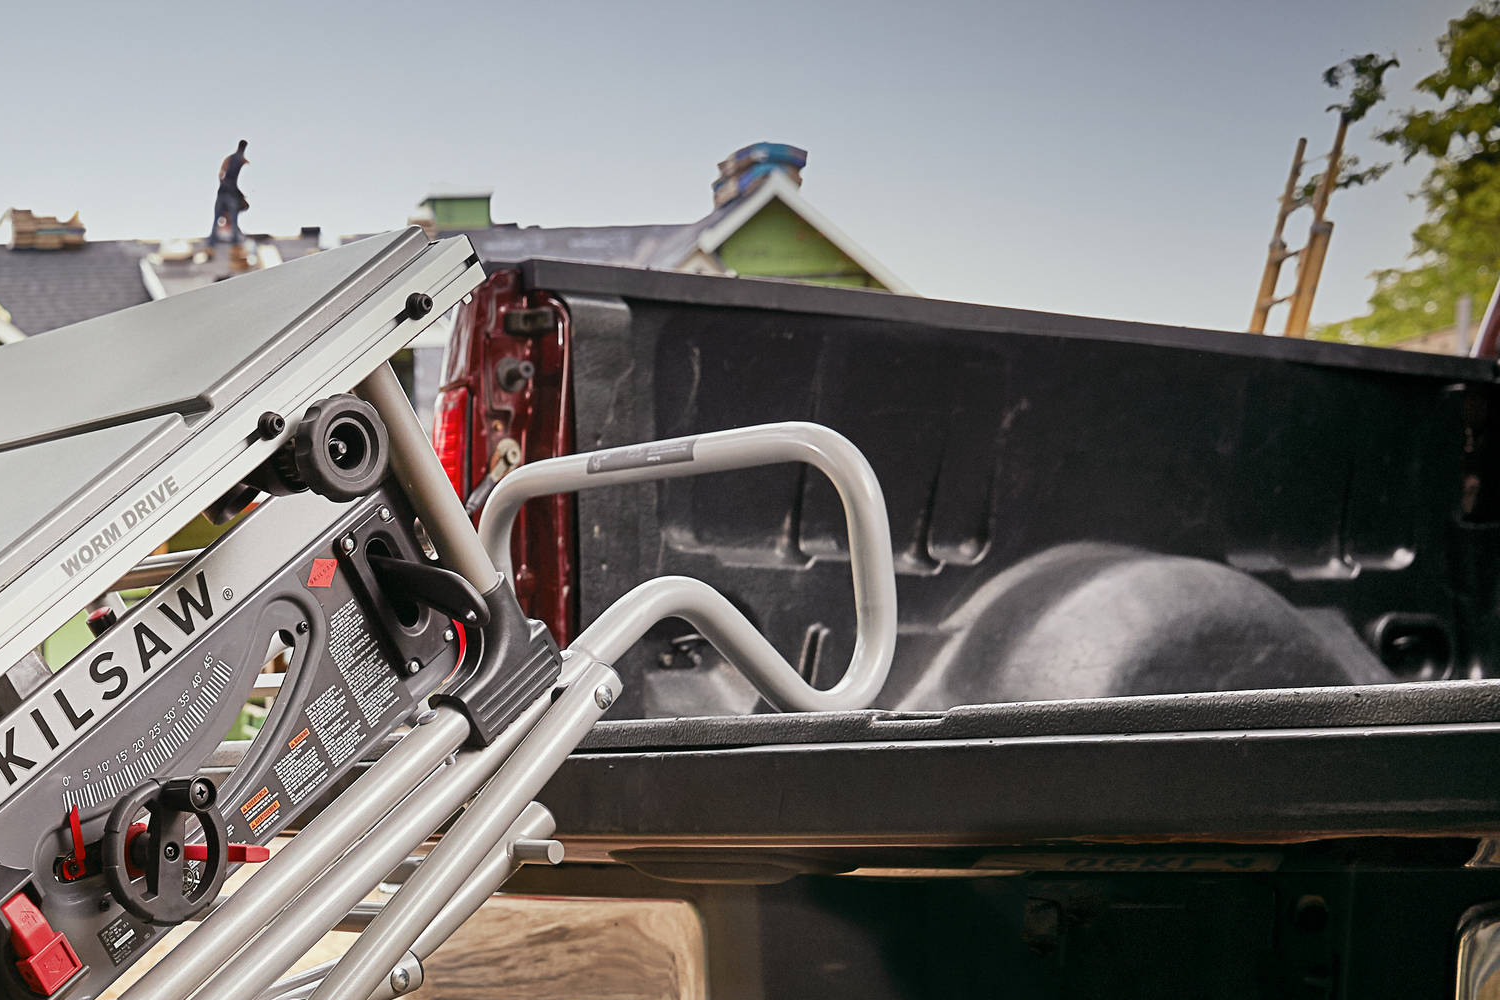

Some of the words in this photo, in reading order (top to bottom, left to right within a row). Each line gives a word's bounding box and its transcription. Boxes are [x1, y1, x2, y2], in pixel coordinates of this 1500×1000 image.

[60, 522, 122, 578] WORM
[121, 475, 179, 529] DRIVE
[203, 652, 214, 669] 45°
[191, 672, 201, 689] 40°
[178, 690, 190, 707] 35°
[163, 707, 176, 724] 30°
[149, 723, 161, 740] 25°
[132, 737, 145, 753] 20°
[115, 750, 128, 764] 15°
[82, 769, 91, 780] 5°
[97, 760, 110, 774] 10°
[62, 775, 71, 787] 0°
